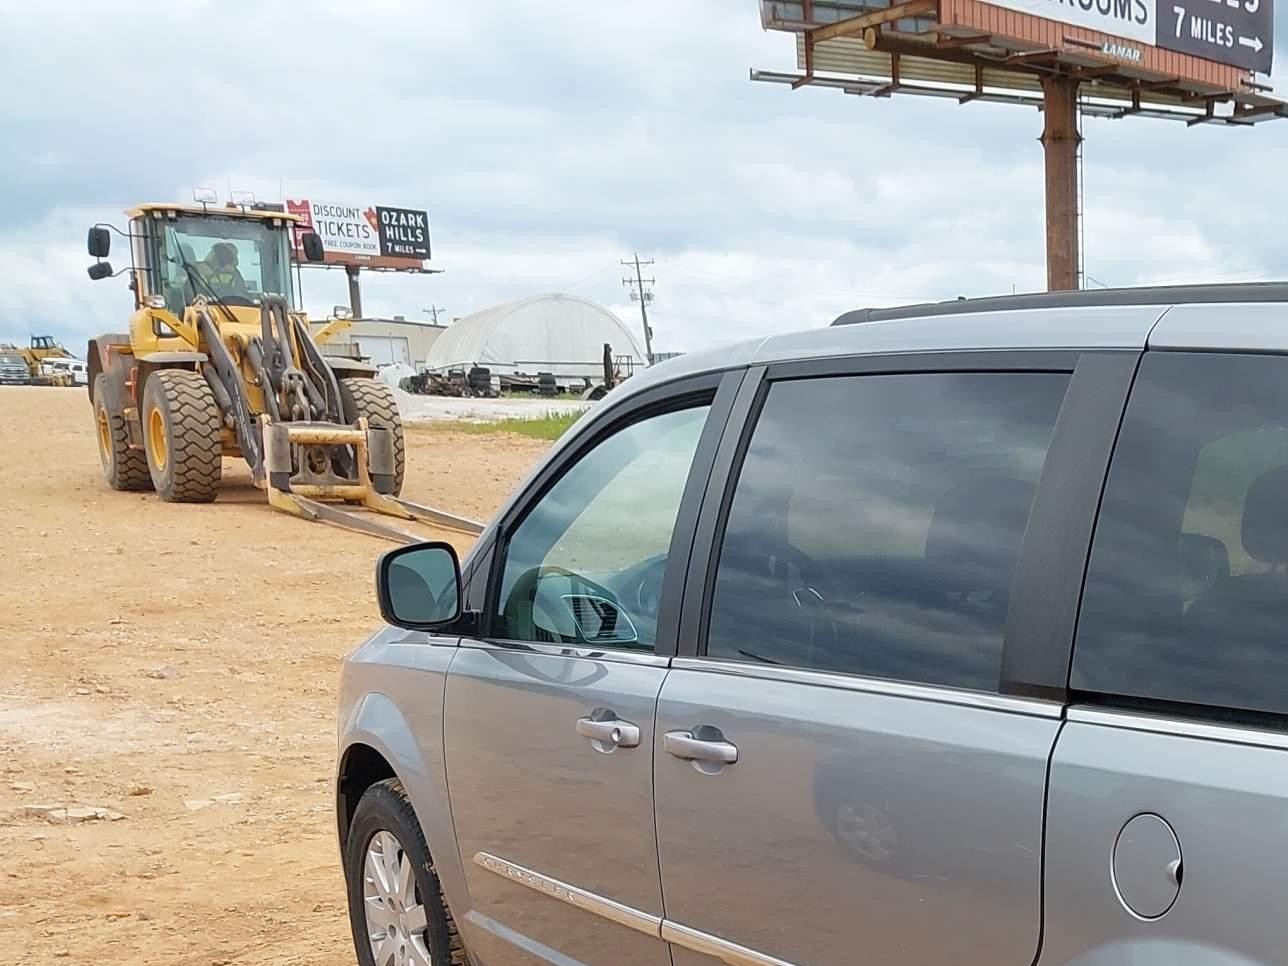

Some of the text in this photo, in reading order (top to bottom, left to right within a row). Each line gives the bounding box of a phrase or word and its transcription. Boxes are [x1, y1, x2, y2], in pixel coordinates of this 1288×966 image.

[1173, 7, 1186, 38] 7
[1190, 15, 1234, 48] MILES
[1102, 42, 1142, 62] LAMAR
[313, 203, 360, 219] DISCOUNT
[381, 211, 425, 228] OZARK
[315, 220, 371, 239] TICKETS
[386, 226, 424, 242] HILLS
[387, 242, 414, 254] 7 MILES
